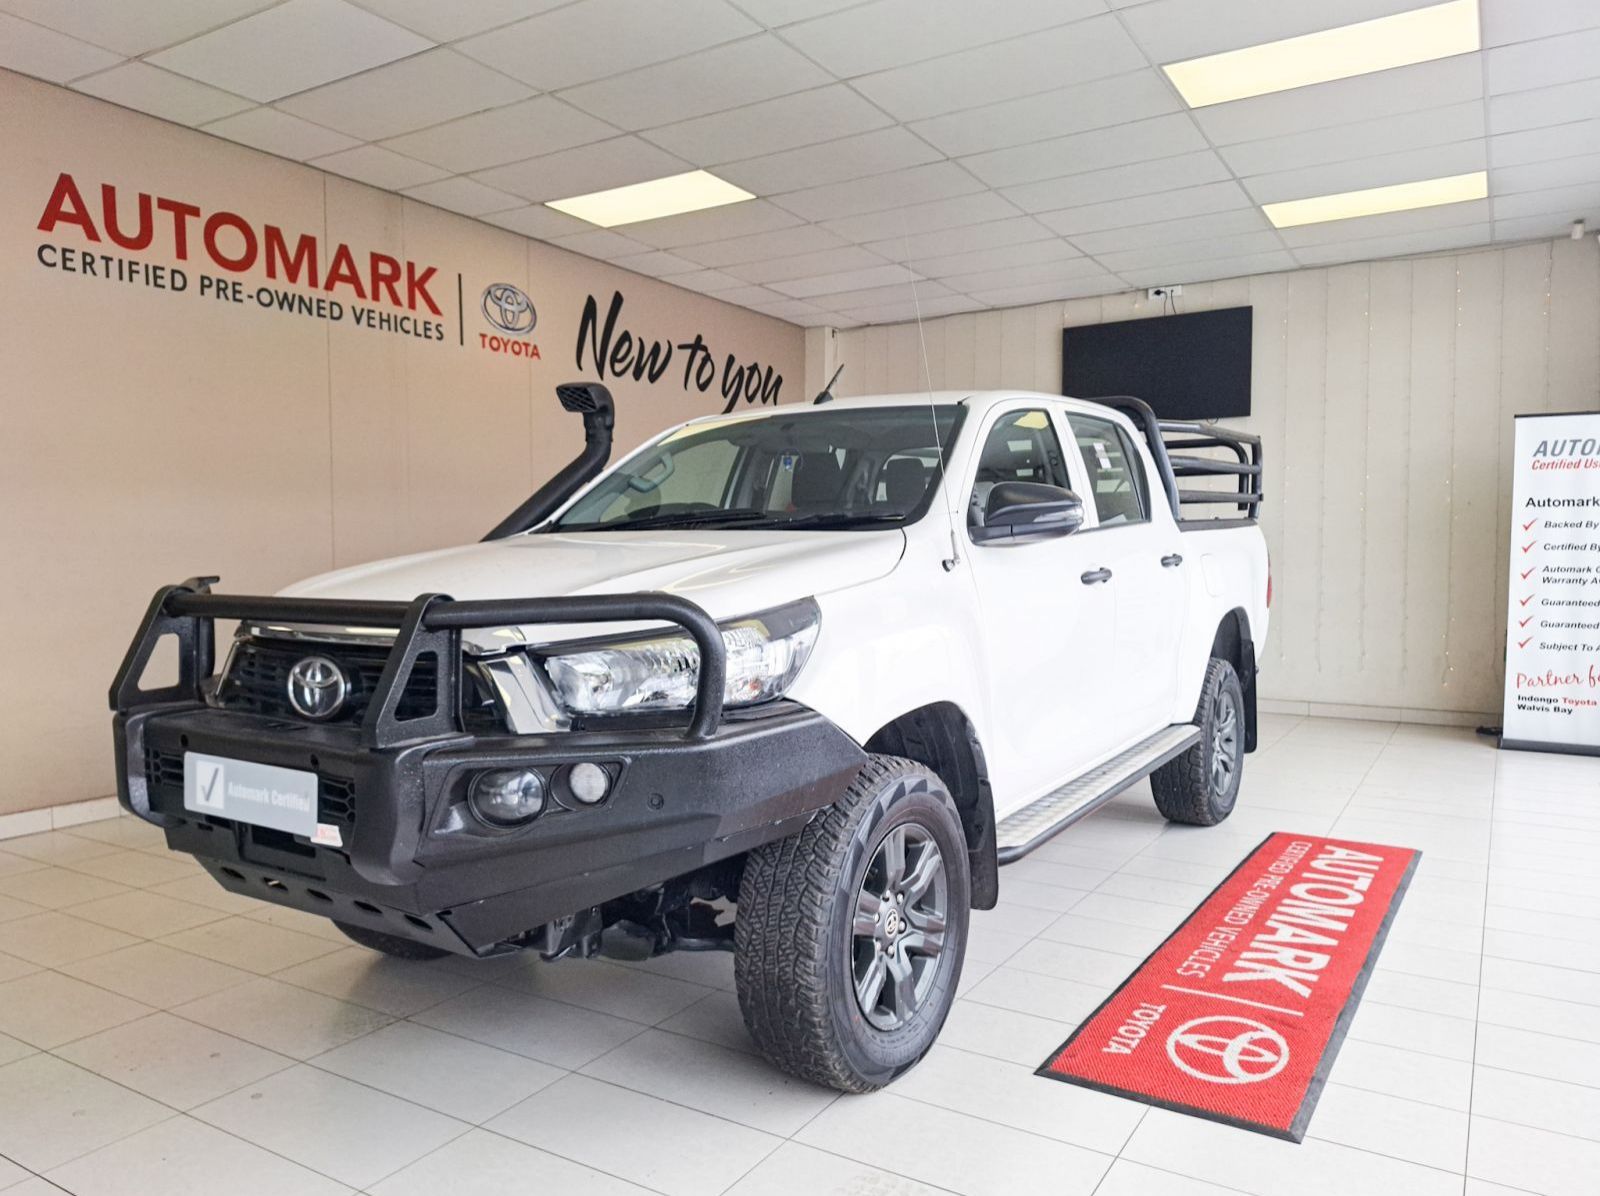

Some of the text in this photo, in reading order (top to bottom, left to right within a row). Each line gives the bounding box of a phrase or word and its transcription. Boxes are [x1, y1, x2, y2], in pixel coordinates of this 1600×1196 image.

[37, 173, 443, 316] AUTOMARK
[37, 244, 445, 341] CERTIFIED PRE-OWNED VEHICLES
[479, 333, 542, 361] TOYOTA
[576, 290, 784, 415] New to you
[1532, 438, 1600, 458] AUTO
[1531, 458, 1600, 471] Certified Us
[1525, 496, 1600, 508] Automark
[1544, 520, 1600, 531] Backed By
[1543, 543, 1587, 552] Certified
[1542, 565, 1592, 574] Automark
[1542, 577, 1588, 586] Warranty
[1541, 598, 1600, 607] Guaranteed
[1540, 620, 1600, 629] Guaranteed
[1539, 642, 1578, 652] Subject
[1580, 643, 1593, 652] To
[1516, 669, 1583, 689] Partner
[1517, 695, 1597, 707] Indongo Toyota
[1517, 704, 1573, 715] Walvis Bay
[228, 781, 310, 812] Automark Certified
[1176, 840, 1313, 979] CERTIFIED PRE-OWNED VEHICLES
[1222, 845, 1384, 998] AUTOMARK
[1102, 1002, 1167, 1055] TOYOTA
